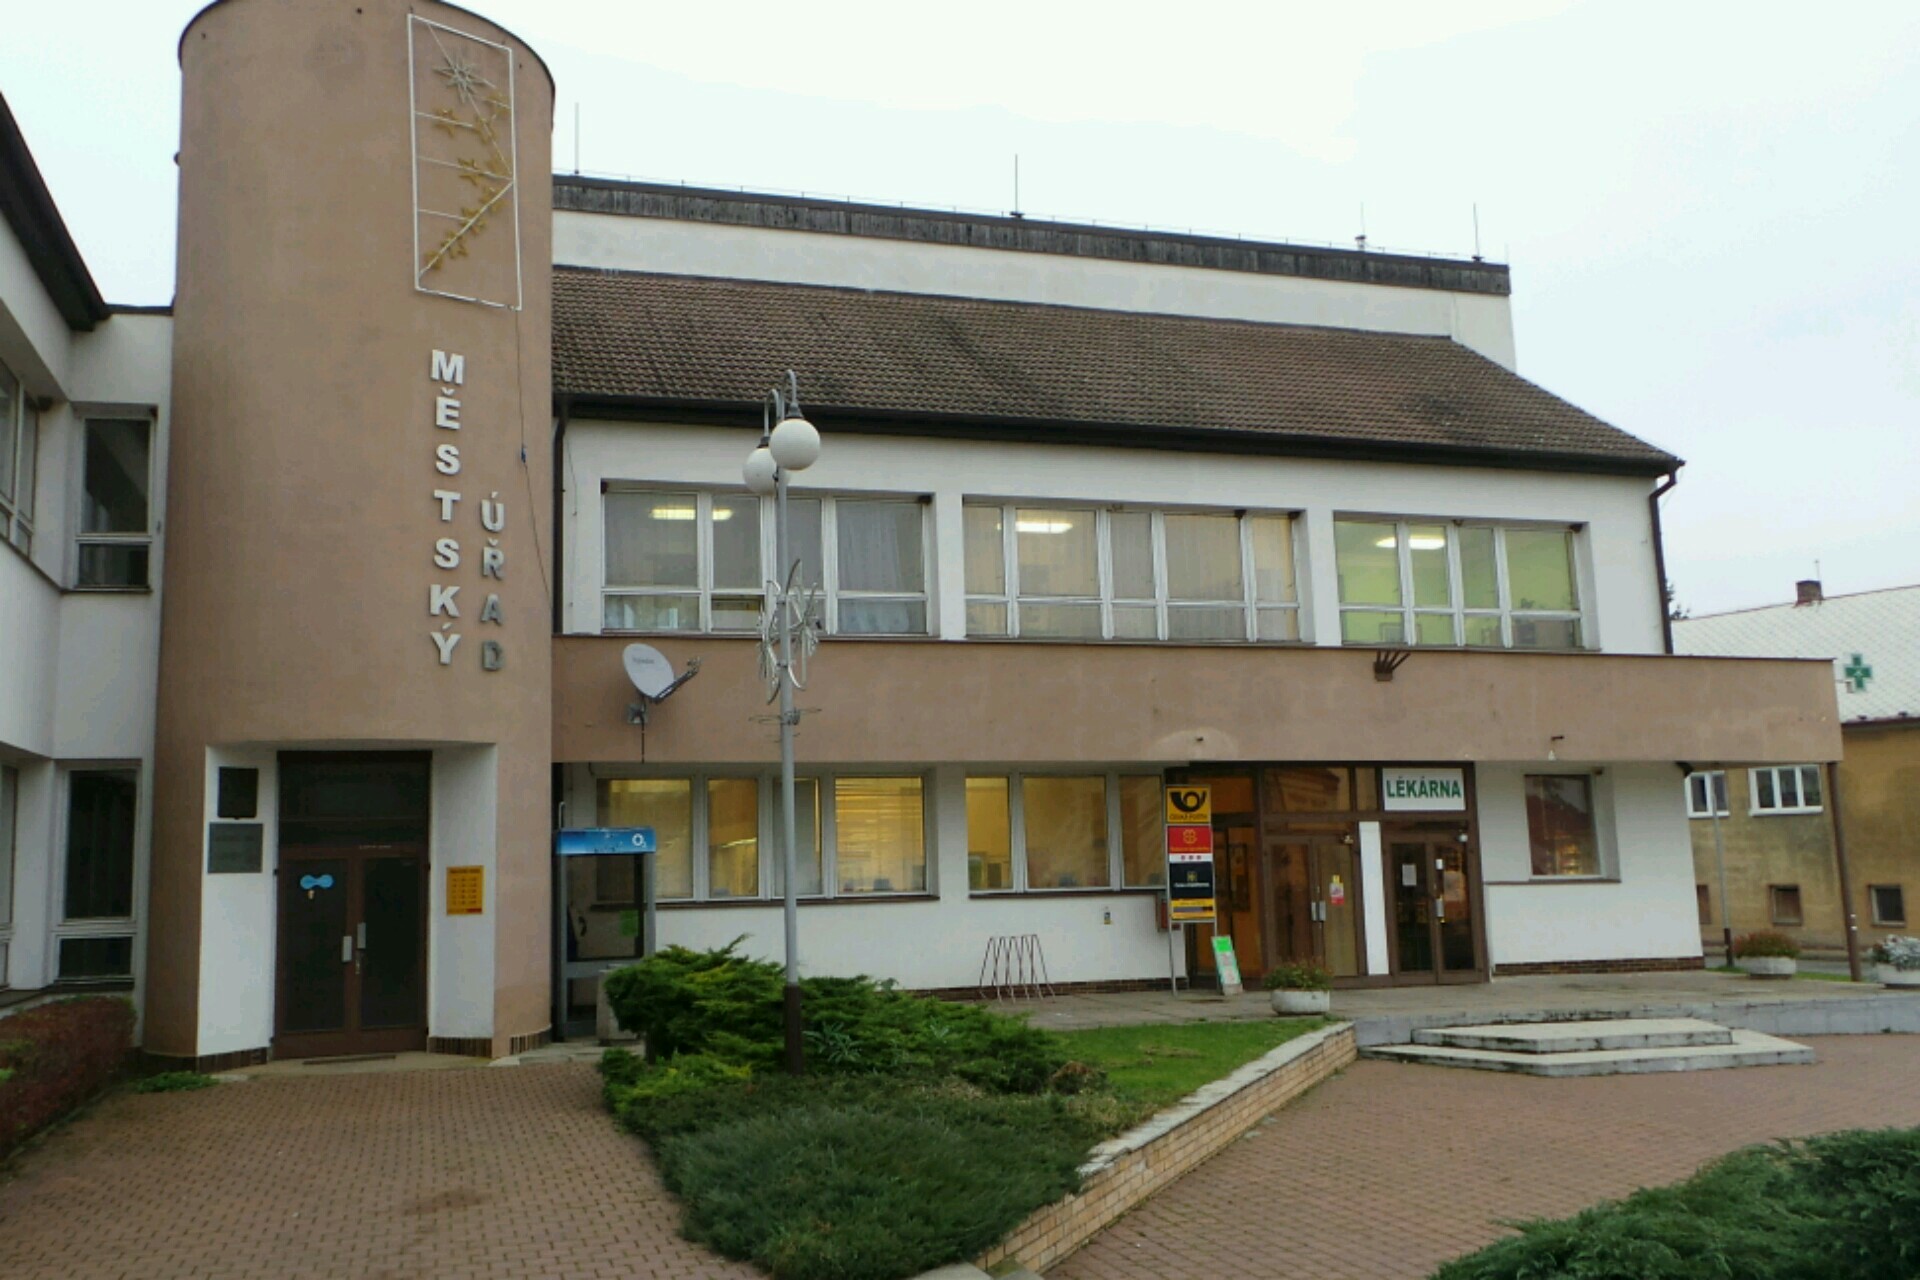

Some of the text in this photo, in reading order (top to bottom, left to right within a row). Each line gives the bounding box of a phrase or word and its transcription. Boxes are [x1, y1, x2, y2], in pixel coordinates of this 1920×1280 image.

[429, 349, 465, 665] MĚSTSKÝ
[480, 491, 506, 671] ÚŘAD
[1386, 776, 1462, 798] LÉKÁRNA
